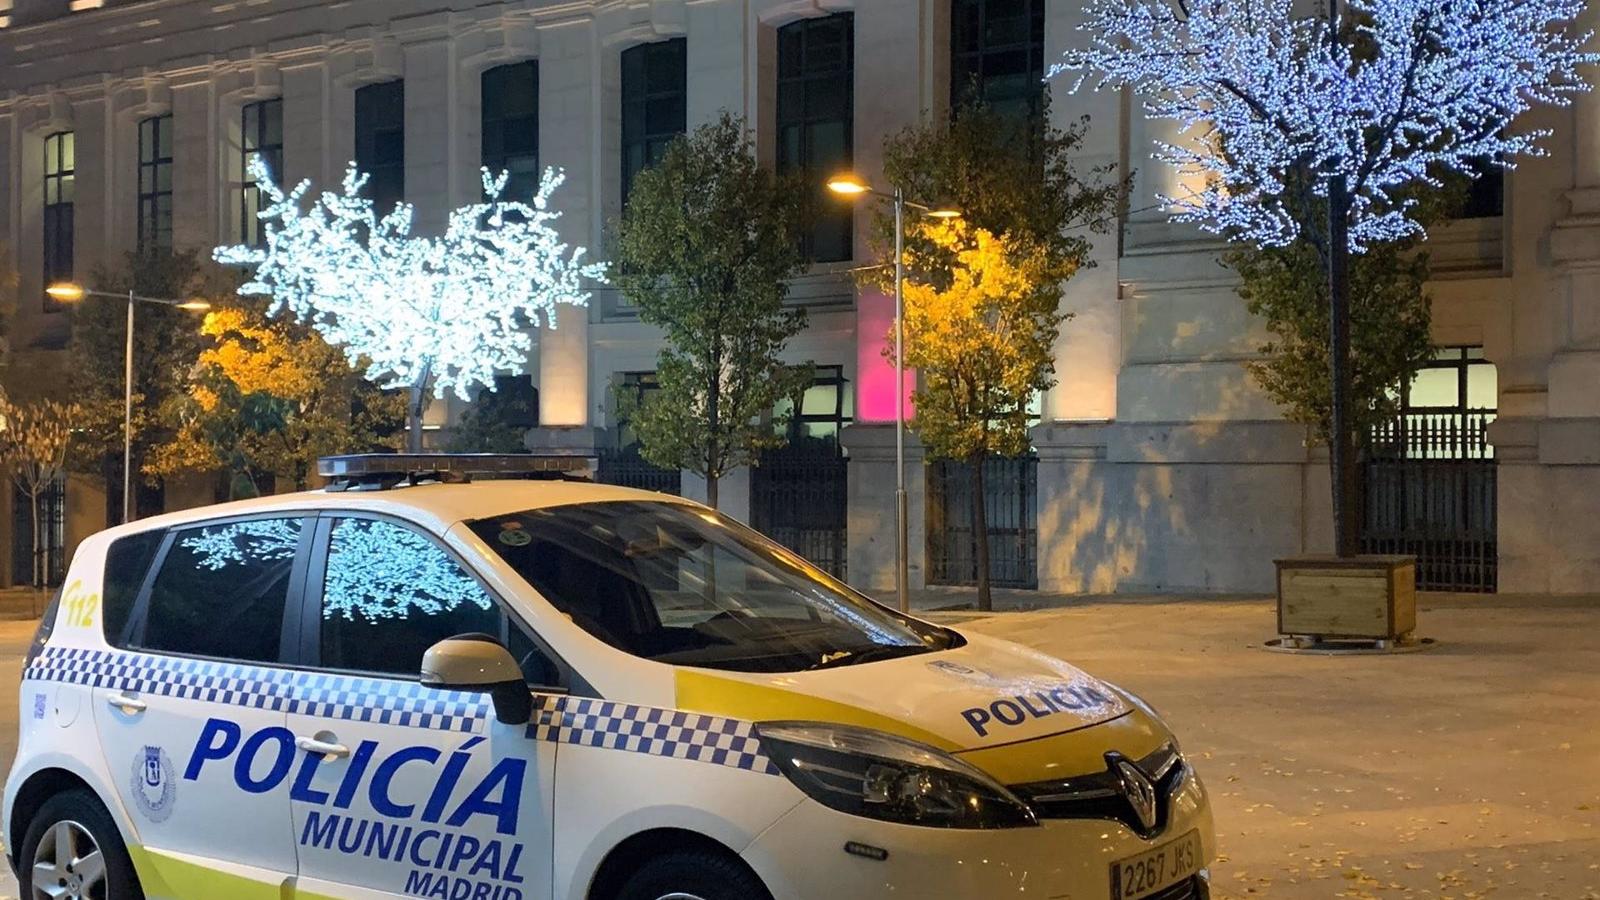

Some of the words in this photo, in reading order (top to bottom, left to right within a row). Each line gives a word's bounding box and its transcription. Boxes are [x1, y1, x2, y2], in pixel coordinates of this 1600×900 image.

[66, 593, 98, 627] 112
[184, 717, 527, 836] POLICÍA
[301, 811, 524, 883] MUNICIPAL
[1124, 853, 1165, 897] 2267
[1171, 840, 1194, 878] JKS
[404, 870, 523, 900] MADRID
